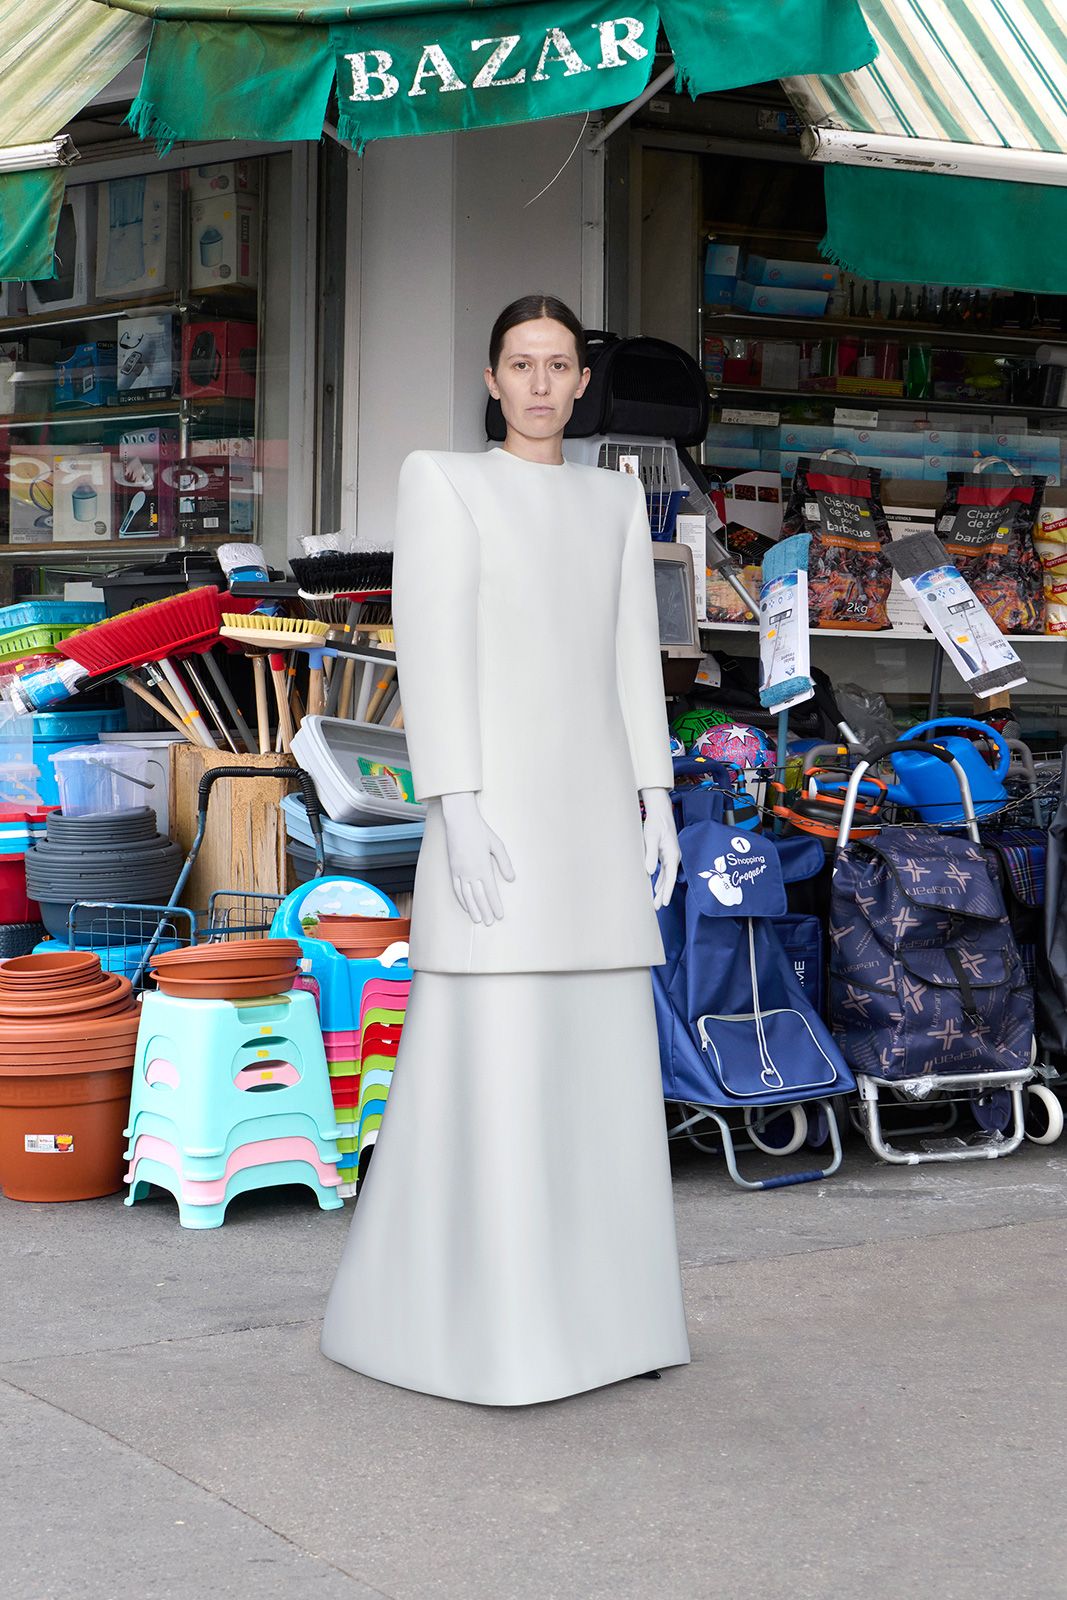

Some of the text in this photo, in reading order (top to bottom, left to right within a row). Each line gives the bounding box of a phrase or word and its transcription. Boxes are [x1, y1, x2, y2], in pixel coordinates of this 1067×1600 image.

[344, 16, 649, 101] BAZAR
[824, 495, 861, 512] Charbon
[829, 507, 841, 517] de
[826, 520, 871, 538] barbecue
[968, 519, 984, 528] de
[846, 602, 868, 616] 2kg
[726, 853, 766, 866] Shopping
[731, 864, 768, 885] Croquer
